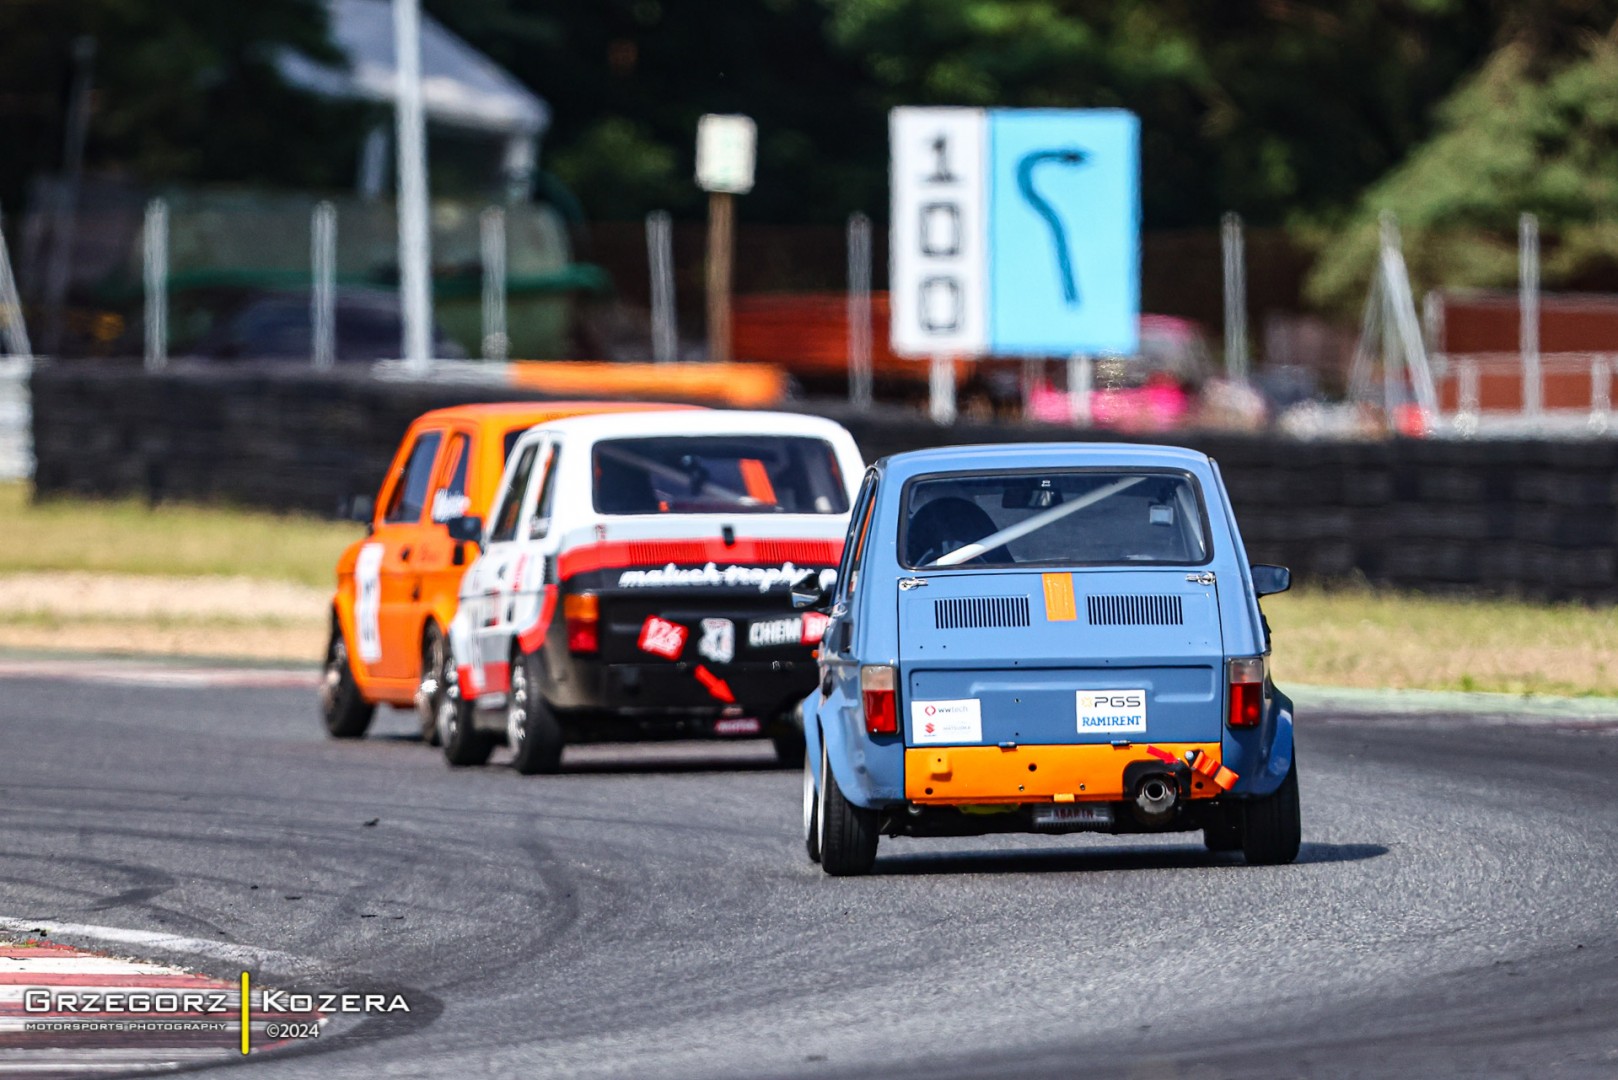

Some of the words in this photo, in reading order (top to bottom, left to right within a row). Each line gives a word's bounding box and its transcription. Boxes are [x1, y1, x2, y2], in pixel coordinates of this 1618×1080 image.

[919, 134, 965, 337] 100
[1094, 696, 1141, 708] PGS
[1082, 715, 1141, 727] RAMIRENT
